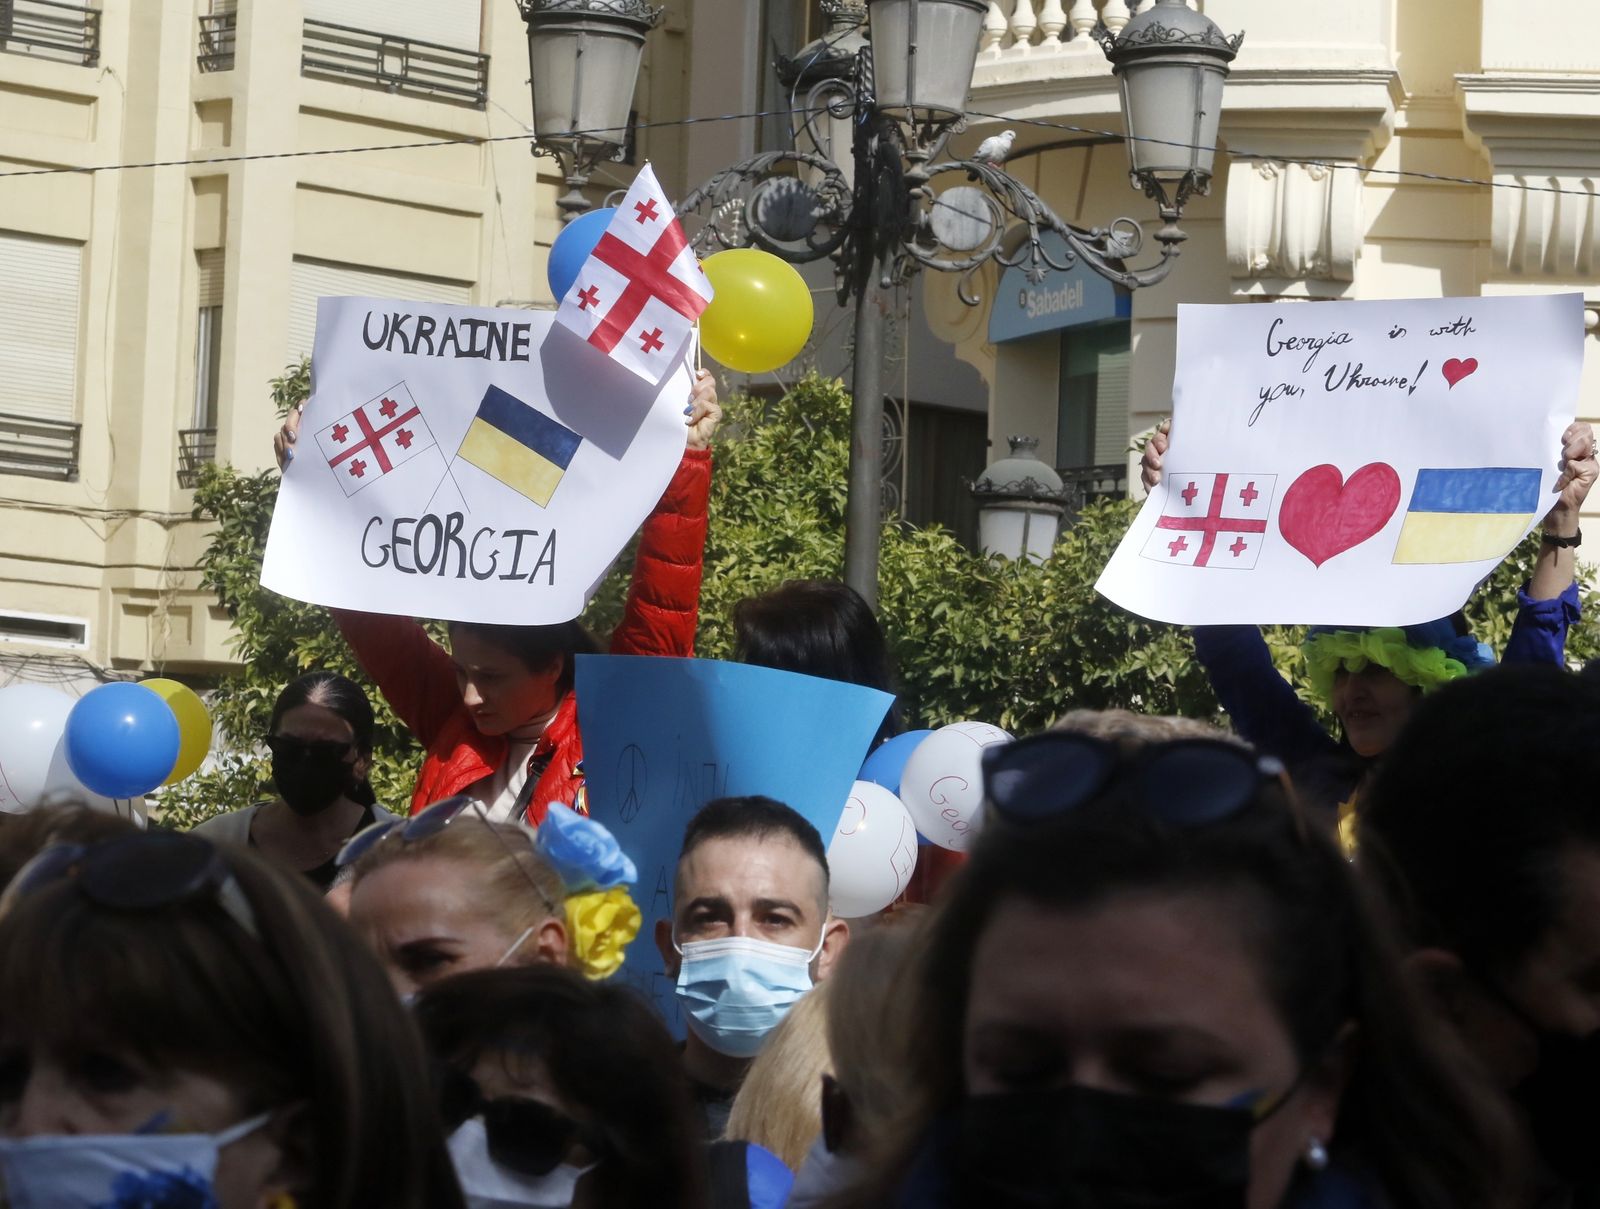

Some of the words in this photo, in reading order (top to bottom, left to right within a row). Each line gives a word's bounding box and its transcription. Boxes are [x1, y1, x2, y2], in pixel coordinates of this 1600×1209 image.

[1027, 279, 1084, 318] Sabadell
[363, 311, 532, 362] UKRAINE
[1267, 318, 1353, 373] Georgia
[1388, 324, 1407, 339] is
[1429, 316, 1476, 337] with
[1248, 383, 1304, 427] you,
[361, 511, 556, 586] GEORGIA
